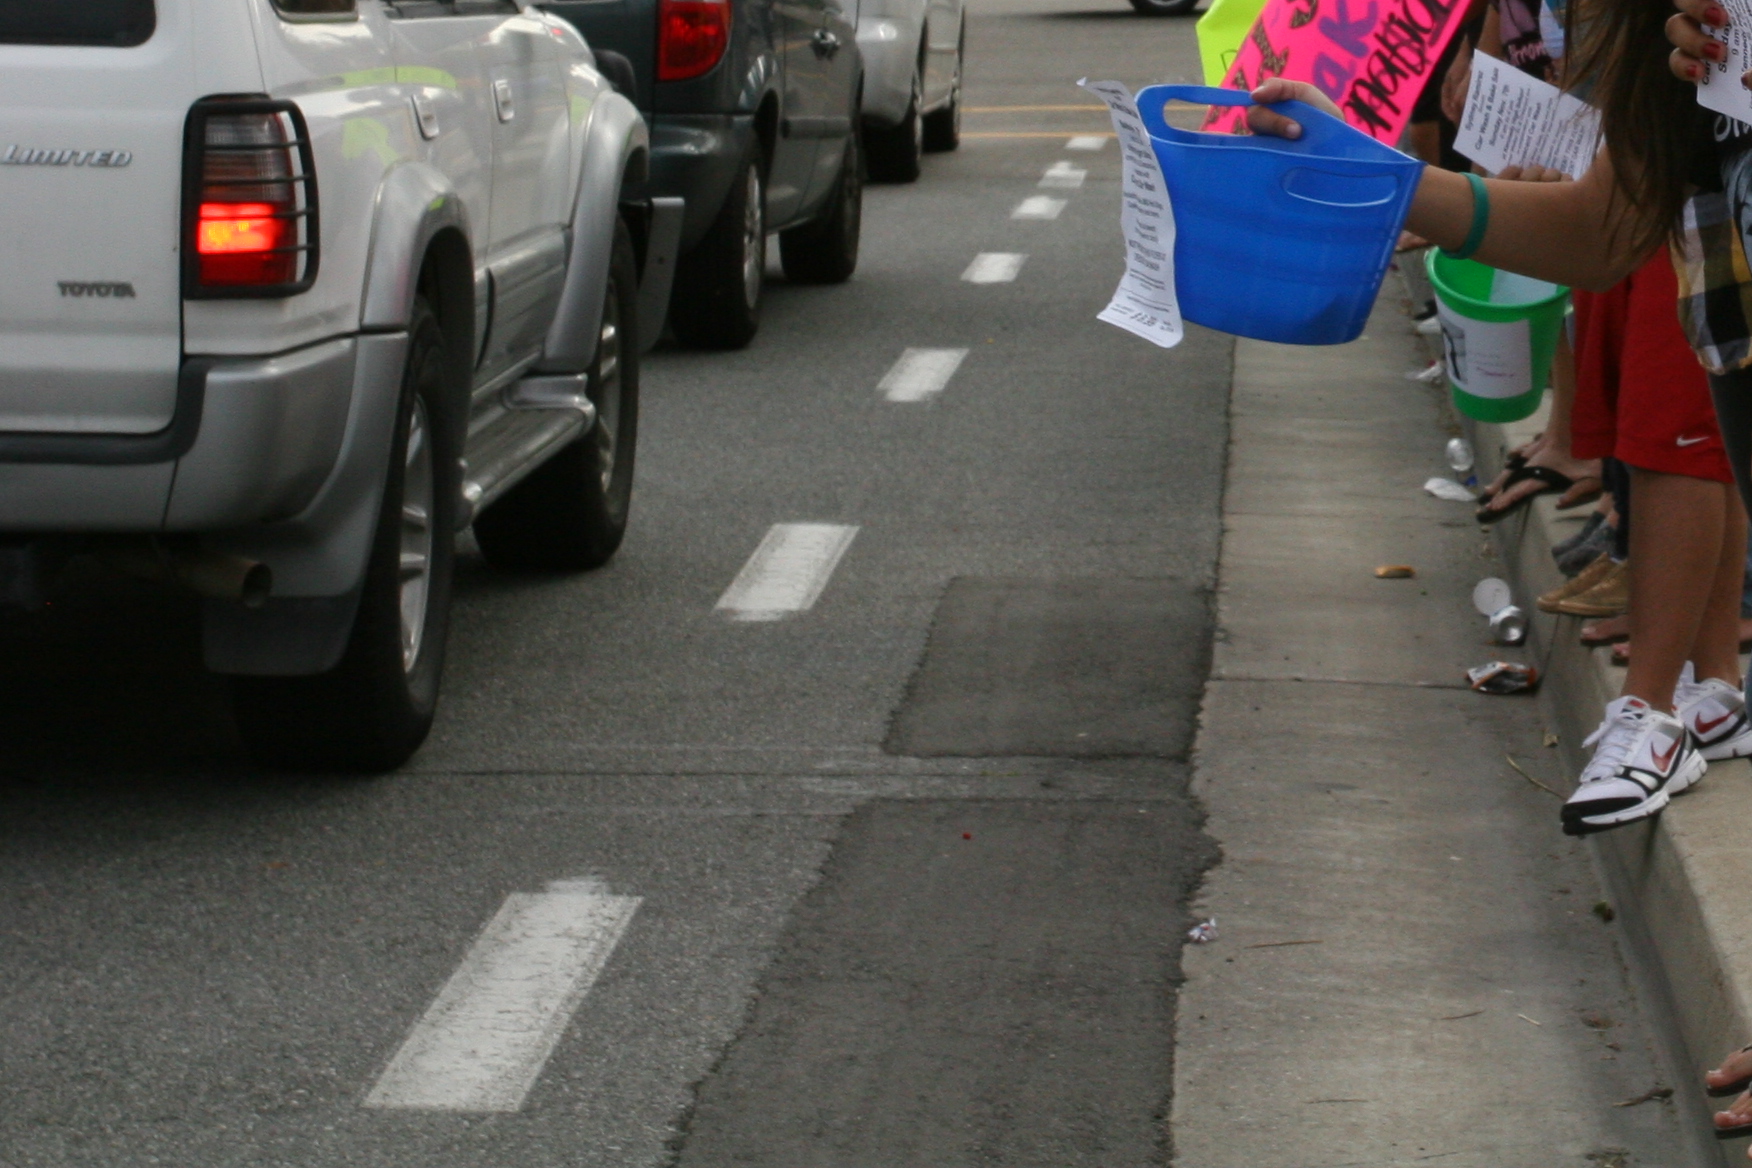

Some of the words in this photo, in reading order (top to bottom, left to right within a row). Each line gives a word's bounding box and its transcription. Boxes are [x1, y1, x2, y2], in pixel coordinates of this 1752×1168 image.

[1486, 83, 1497, 103] Bake
[1464, 101, 1477, 131] Sydney
[1478, 111, 1490, 133] Wash
[1488, 116, 1503, 145] Sunday
[1501, 83, 1510, 96] 7th
[1527, 121, 1536, 134] Car
[1532, 102, 1541, 120] Wash
[1474, 134, 1483, 150] Car
[1, 144, 133, 167] LIMITED
[57, 281, 137, 299] TOYOTA
